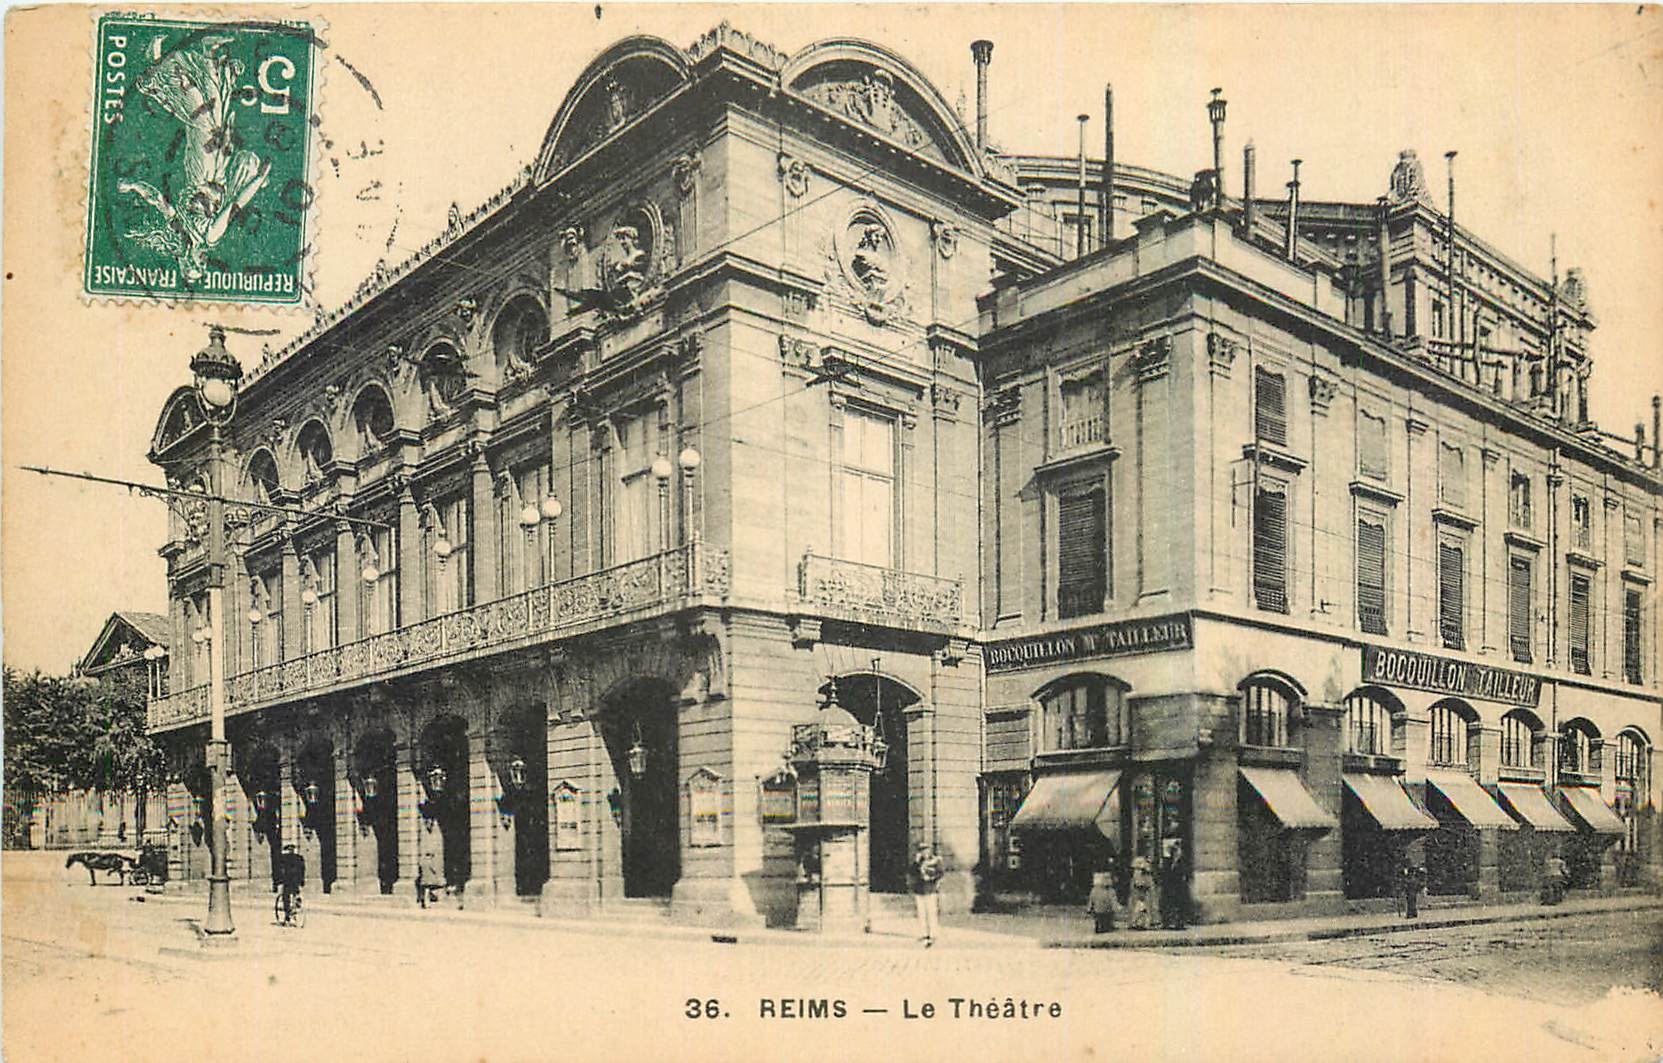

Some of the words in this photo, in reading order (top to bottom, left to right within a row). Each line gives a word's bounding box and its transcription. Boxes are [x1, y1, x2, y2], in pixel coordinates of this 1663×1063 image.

[104, 34, 128, 125] POSTES
[94, 265, 177, 289] FRANÇAISE
[1106, 622, 1187, 649] TAILLEUR
[1376, 651, 1465, 691] BOCQUILLON
[1477, 669, 1535, 700] TAILLEUR
